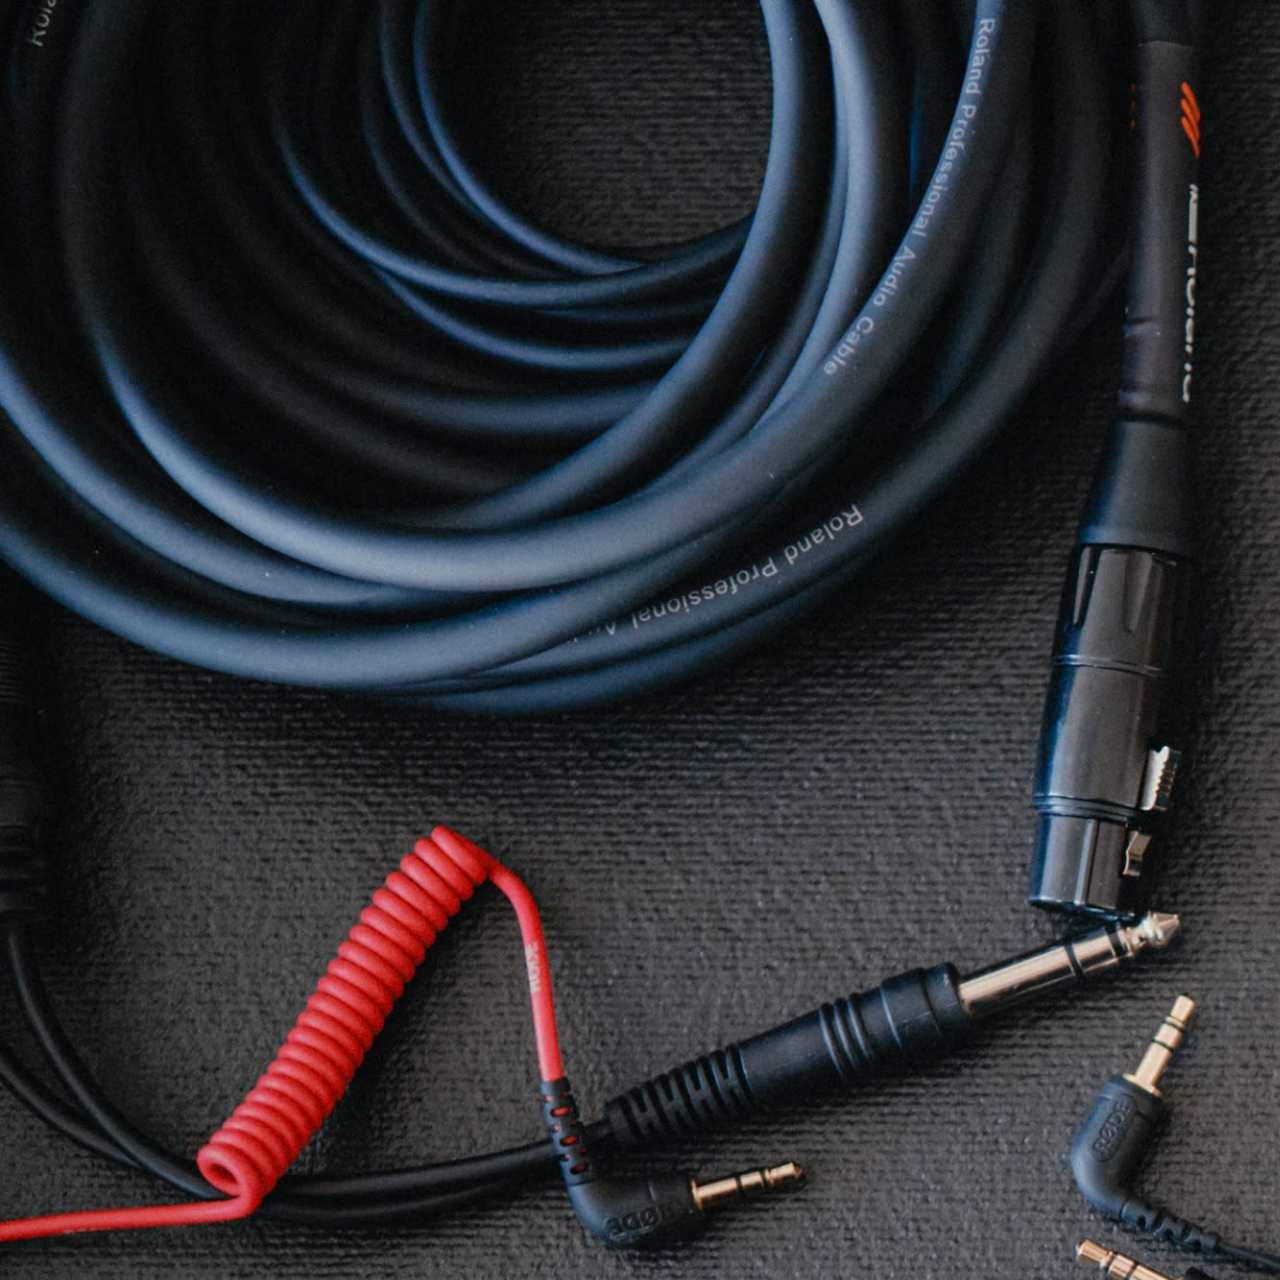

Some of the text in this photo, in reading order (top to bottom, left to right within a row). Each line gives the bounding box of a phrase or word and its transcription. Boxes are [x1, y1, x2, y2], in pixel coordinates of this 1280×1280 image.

[824, 18, 996, 374] Roland Professional Audio Cable
[631, 504, 864, 629] Roland Professional
